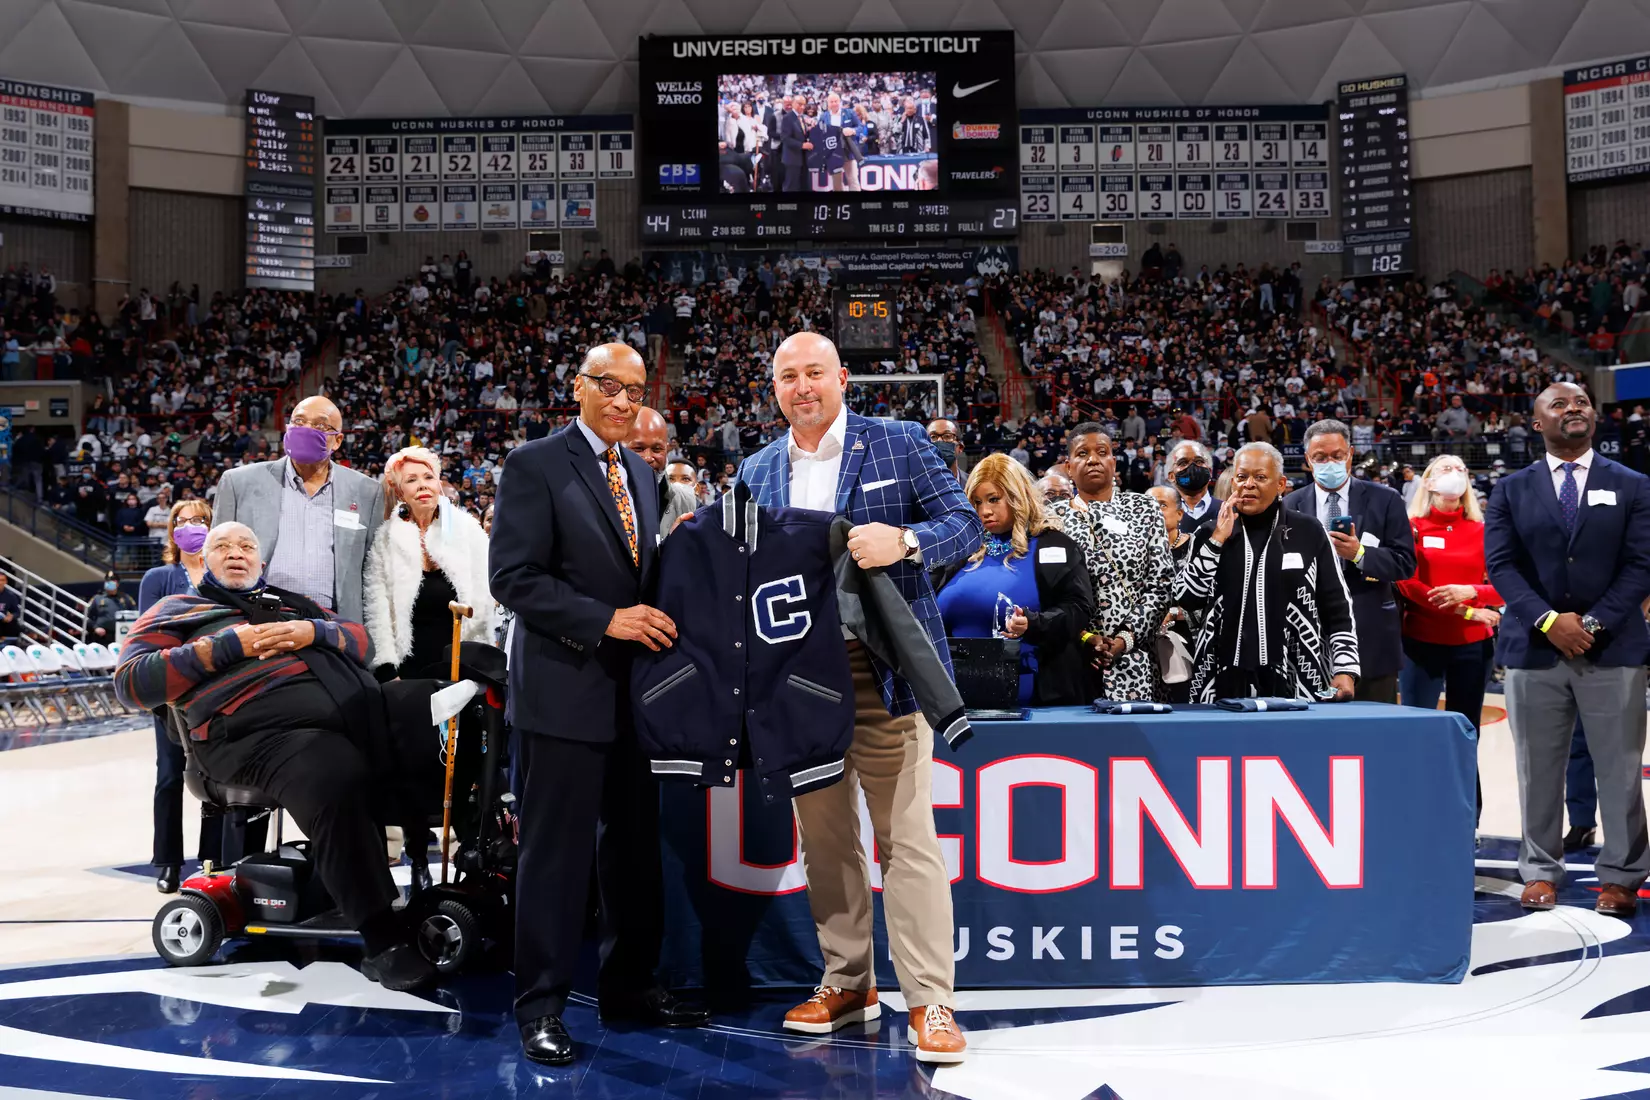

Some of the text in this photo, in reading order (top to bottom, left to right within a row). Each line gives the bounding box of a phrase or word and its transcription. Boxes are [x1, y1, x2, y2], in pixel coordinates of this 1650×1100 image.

[673, 37, 981, 58] UNIVERSITY OF CONNECTICUT
[1577, 63, 1626, 81] NCAA
[656, 82, 702, 92] WELLS
[1341, 77, 1404, 93] GO HUSKIES
[657, 94, 702, 105] FARGO
[1570, 95, 1591, 110] 1991
[1600, 89, 1624, 105] 1994
[36, 112, 58, 128] 1994
[1087, 108, 1260, 119] UCONN HUSKIES OF HONOR
[1569, 114, 1593, 129] 2000
[1602, 109, 1625, 125] 2001
[67, 117, 89, 133] 1995
[392, 119, 565, 129] UCONN HUSKIES OF HONOR
[2, 128, 27, 144] 2000
[35, 132, 58, 148] 2001
[966, 131, 999, 139] DONUTS
[1569, 134, 1593, 149] 2007
[2, 148, 26, 163] 2007
[1031, 145, 1045, 163] 32
[1073, 145, 1081, 163] 3
[1148, 144, 1163, 161] 20
[1187, 143, 1200, 161] 31
[1224, 143, 1240, 160] 23
[1262, 142, 1278, 160] 31
[1301, 141, 1318, 159] 14
[1602, 149, 1626, 165] 2015
[330, 156, 356, 174] 24
[369, 156, 395, 173] 50
[411, 155, 431, 173] 21
[448, 155, 472, 172] 52
[486, 154, 512, 171] 42
[529, 153, 547, 171] 25
[570, 152, 585, 170] 33
[609, 152, 623, 169] 10
[1571, 154, 1594, 169] 2014
[2, 168, 26, 183] 2014
[659, 164, 696, 176] CBS
[951, 171, 995, 179] TRAVELERS
[1027, 194, 1050, 212] 23
[1072, 194, 1083, 211] 4
[1106, 193, 1127, 211] 30
[1151, 192, 1161, 211] 3
[1183, 192, 1205, 210] CD
[1225, 192, 1241, 209] 15
[1259, 192, 1286, 209] 24
[1299, 191, 1324, 209] 33
[646, 215, 670, 232] 44
[993, 208, 1017, 228] 27
[684, 227, 701, 236] FULL
[712, 226, 719, 237] 2
[731, 226, 745, 235] SEC
[757, 225, 791, 236] 0 TM FLS
[869, 223, 905, 233] TM FLS 0
[925, 223, 940, 232] SEC
[958, 223, 976, 232] FULL
[838, 254, 859, 262] Harry
[870, 253, 899, 262] Gampel
[901, 252, 930, 260] Pavilion
[962, 251, 973, 259] CT
[1104, 246, 1127, 255] 204
[848, 263, 887, 271] Basketball
[888, 262, 915, 271] Capital
[1372, 254, 1402, 272] 1:02
[849, 301, 888, 318] 10:15
[1600, 440, 1620, 453] 05
[751, 574, 812, 645] C
[888, 924, 1185, 962] USKIES
